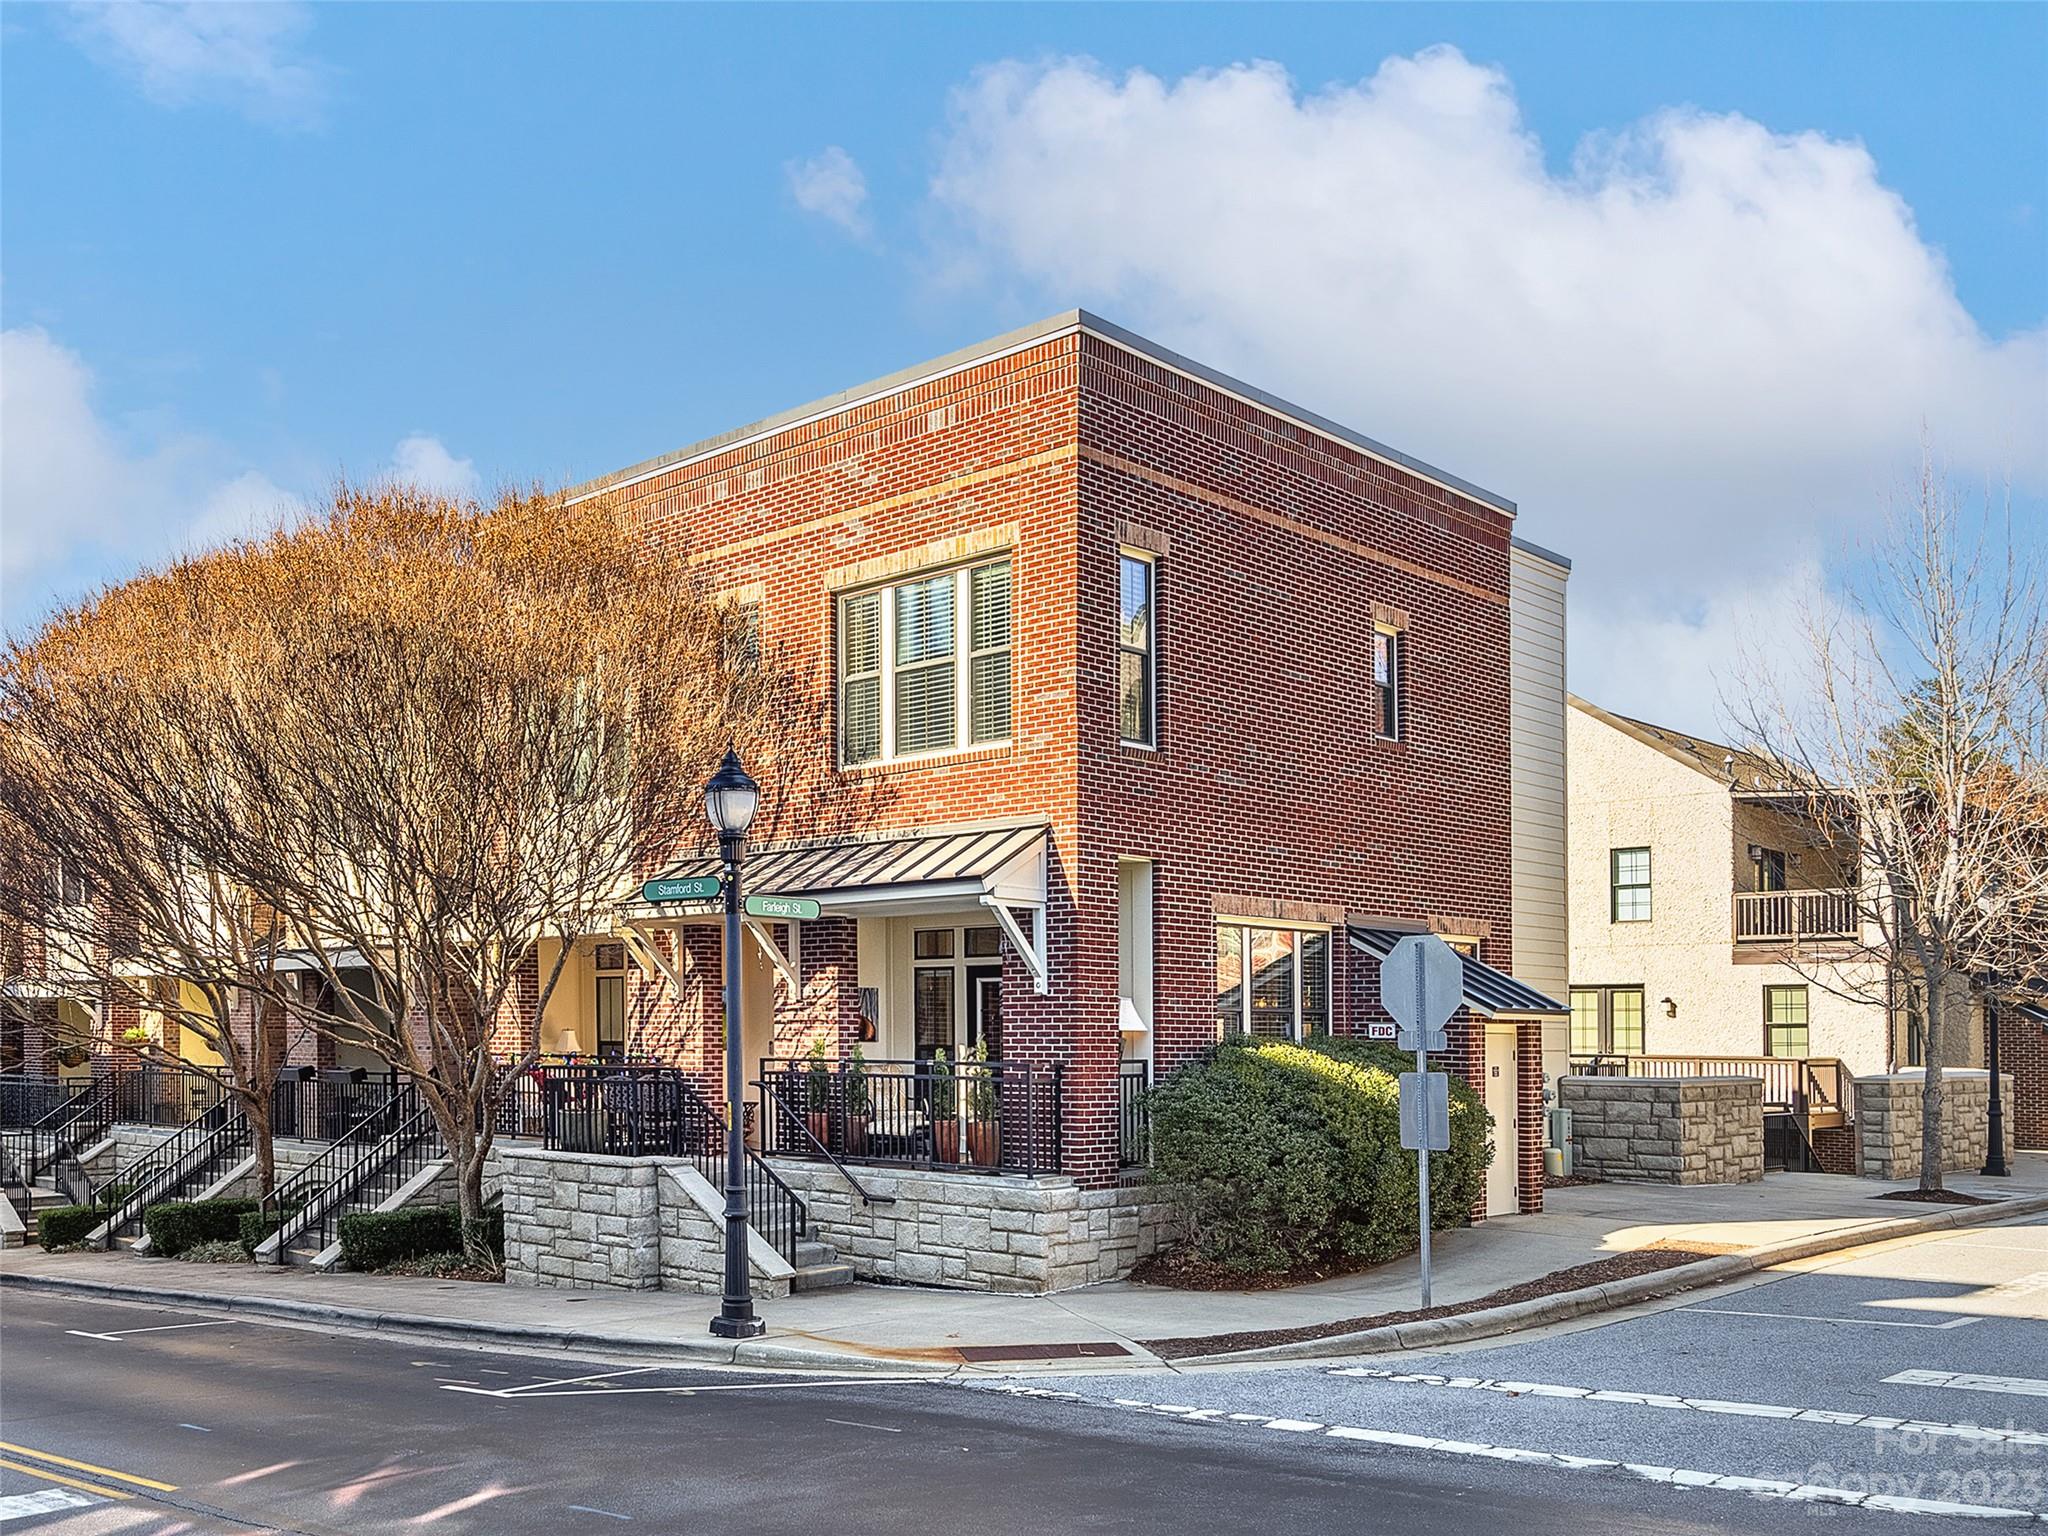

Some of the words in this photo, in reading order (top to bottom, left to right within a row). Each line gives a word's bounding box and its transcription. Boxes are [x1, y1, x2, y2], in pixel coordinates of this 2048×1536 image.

[657, 883, 692, 896] Stamford
[693, 882, 704, 893] St.
[762, 901, 791, 915] Farleigh
[792, 903, 802, 914] St.
[1371, 1026, 1393, 1037] FDC
